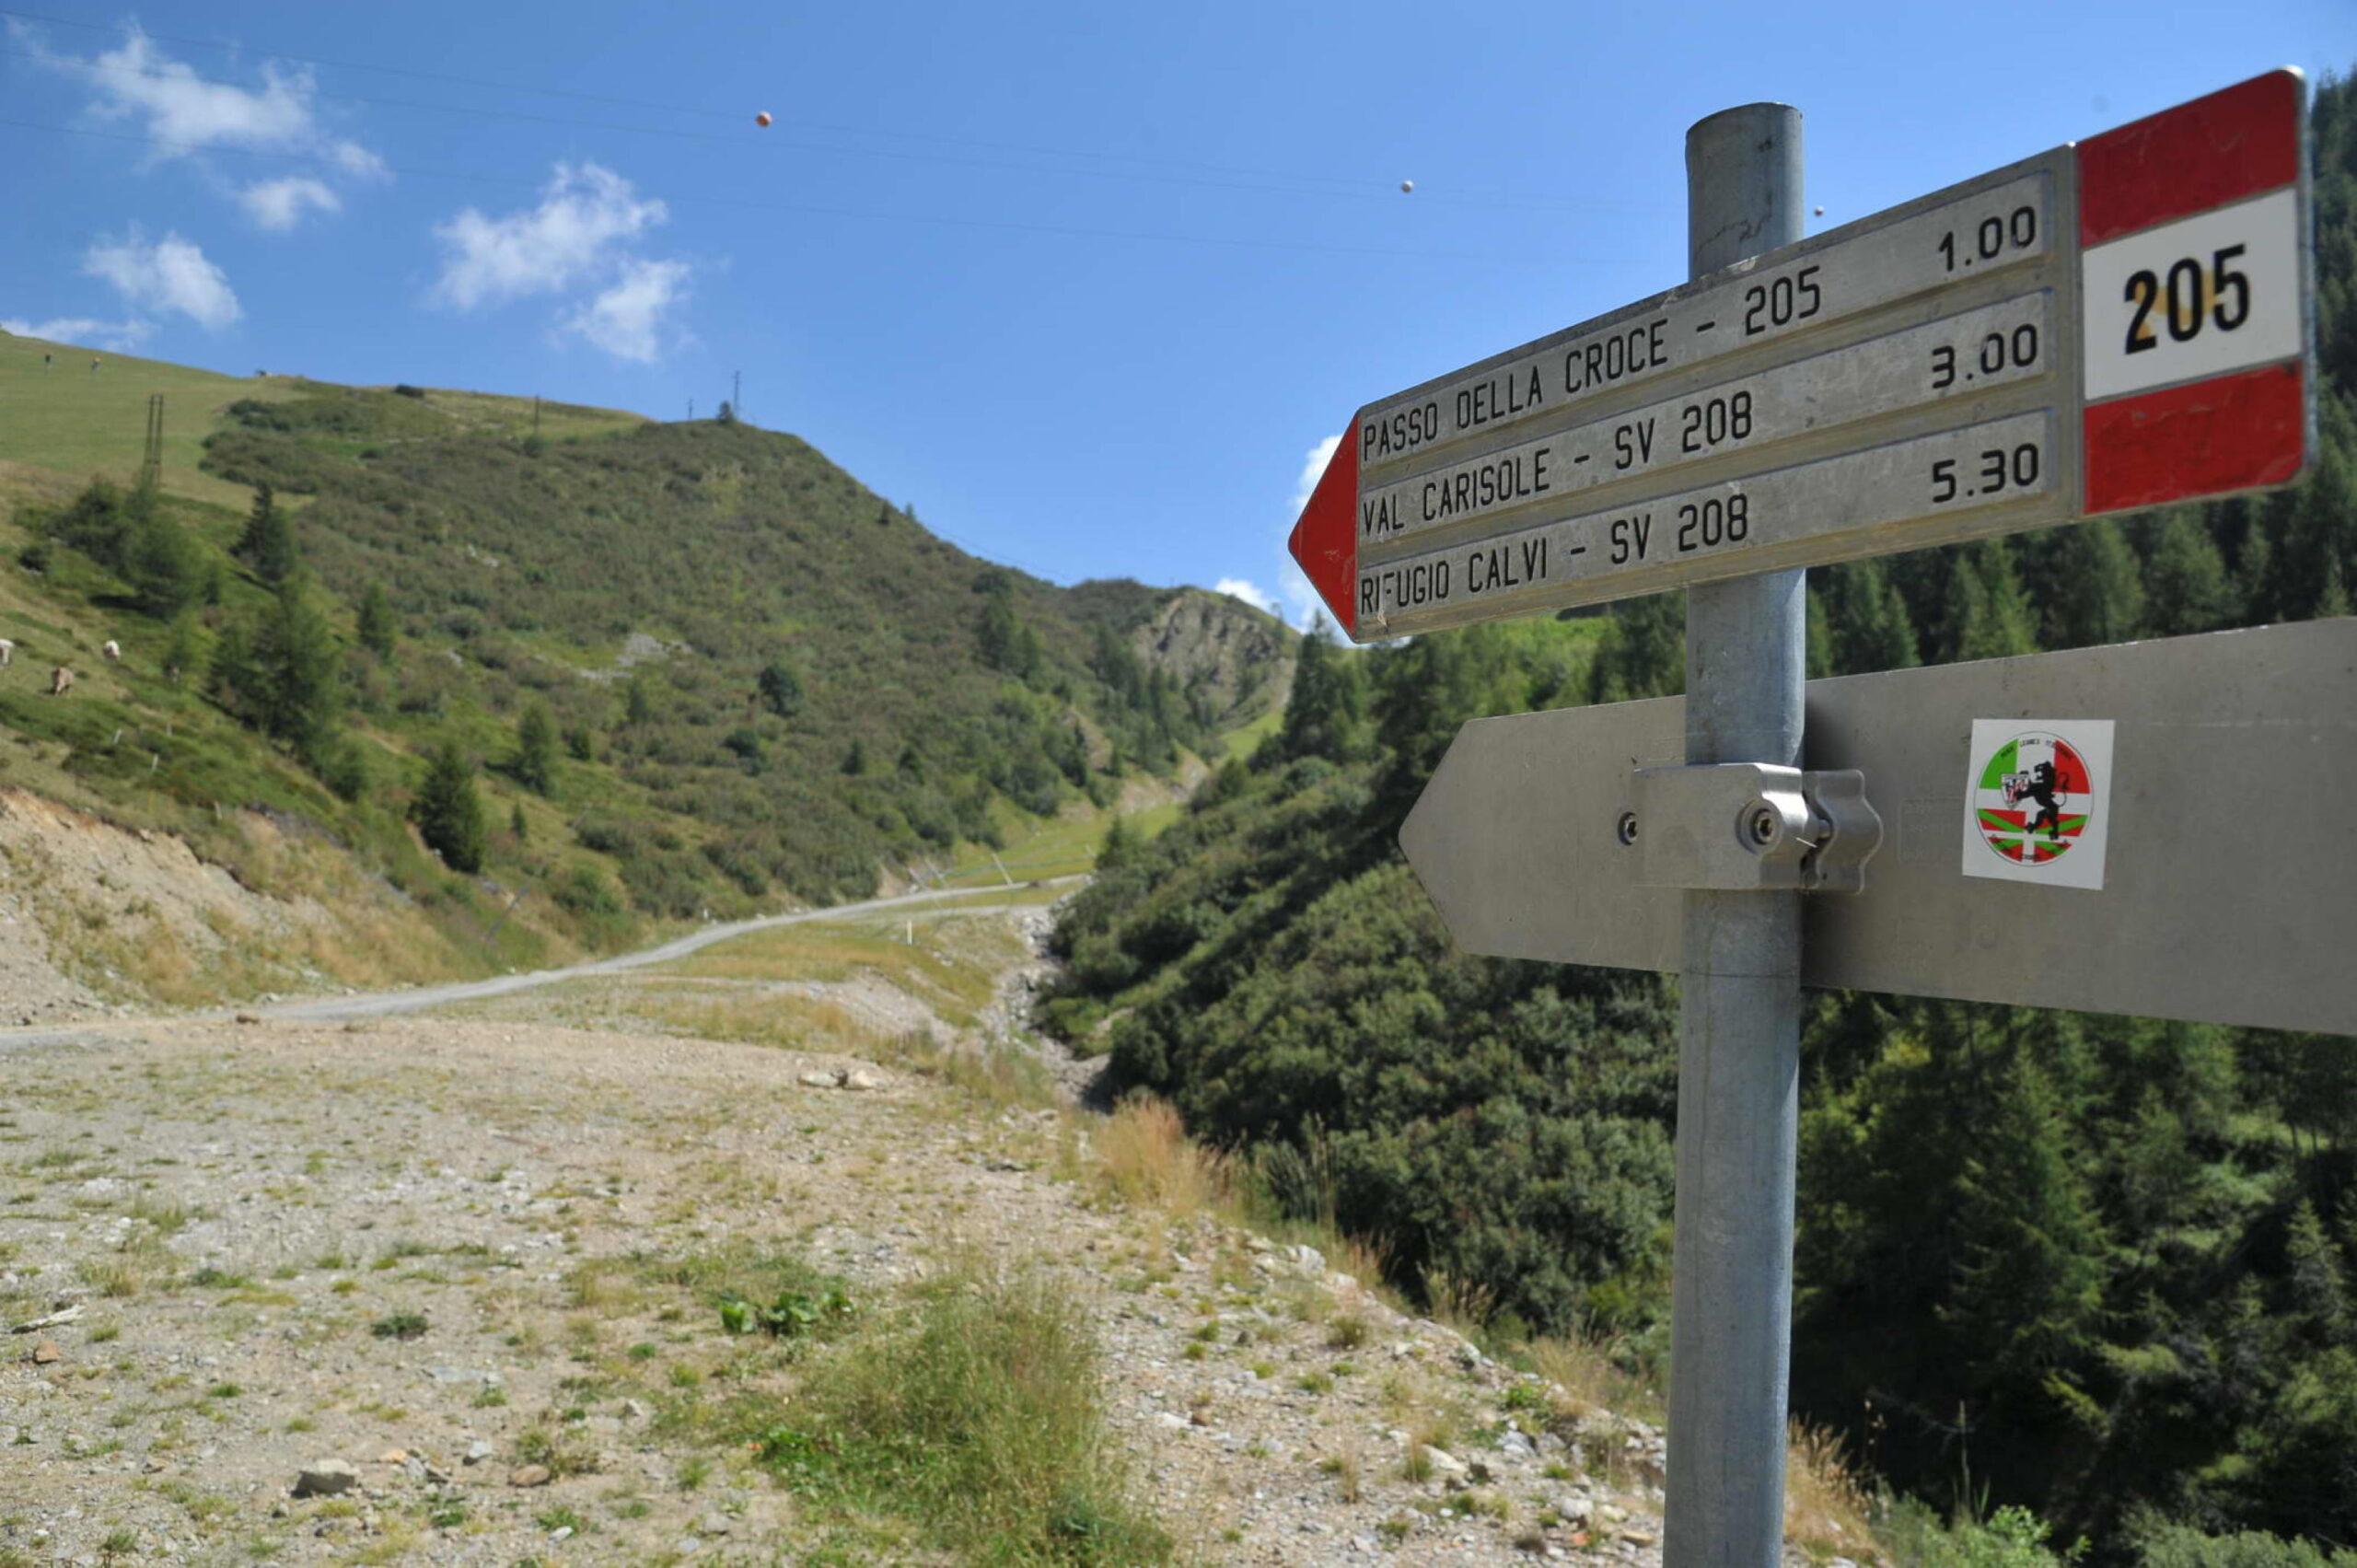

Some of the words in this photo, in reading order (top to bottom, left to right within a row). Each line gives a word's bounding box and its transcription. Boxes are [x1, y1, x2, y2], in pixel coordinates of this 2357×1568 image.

[1364, 402, 1438, 462] PASSO
[1457, 366, 1543, 429] DELLA
[1565, 318, 1668, 394] CROCE
[1696, 320, 1715, 332] -
[1745, 265, 1820, 336] 205
[1937, 205, 2036, 272] 1.00
[2124, 243, 2250, 355] 205
[1363, 494, 1405, 536] VAL
[1422, 447, 1550, 521] CARISOLE
[1573, 454, 1590, 464] -
[1615, 417, 1655, 470] SV
[1681, 390, 1752, 454] 208
[1932, 323, 2038, 389] 3.00
[1468, 537, 1547, 593] CALVI
[1570, 546, 1586, 555] -
[1610, 514, 1651, 564] SV
[1678, 493, 1747, 552] 208
[1932, 443, 2039, 504] 5.30
